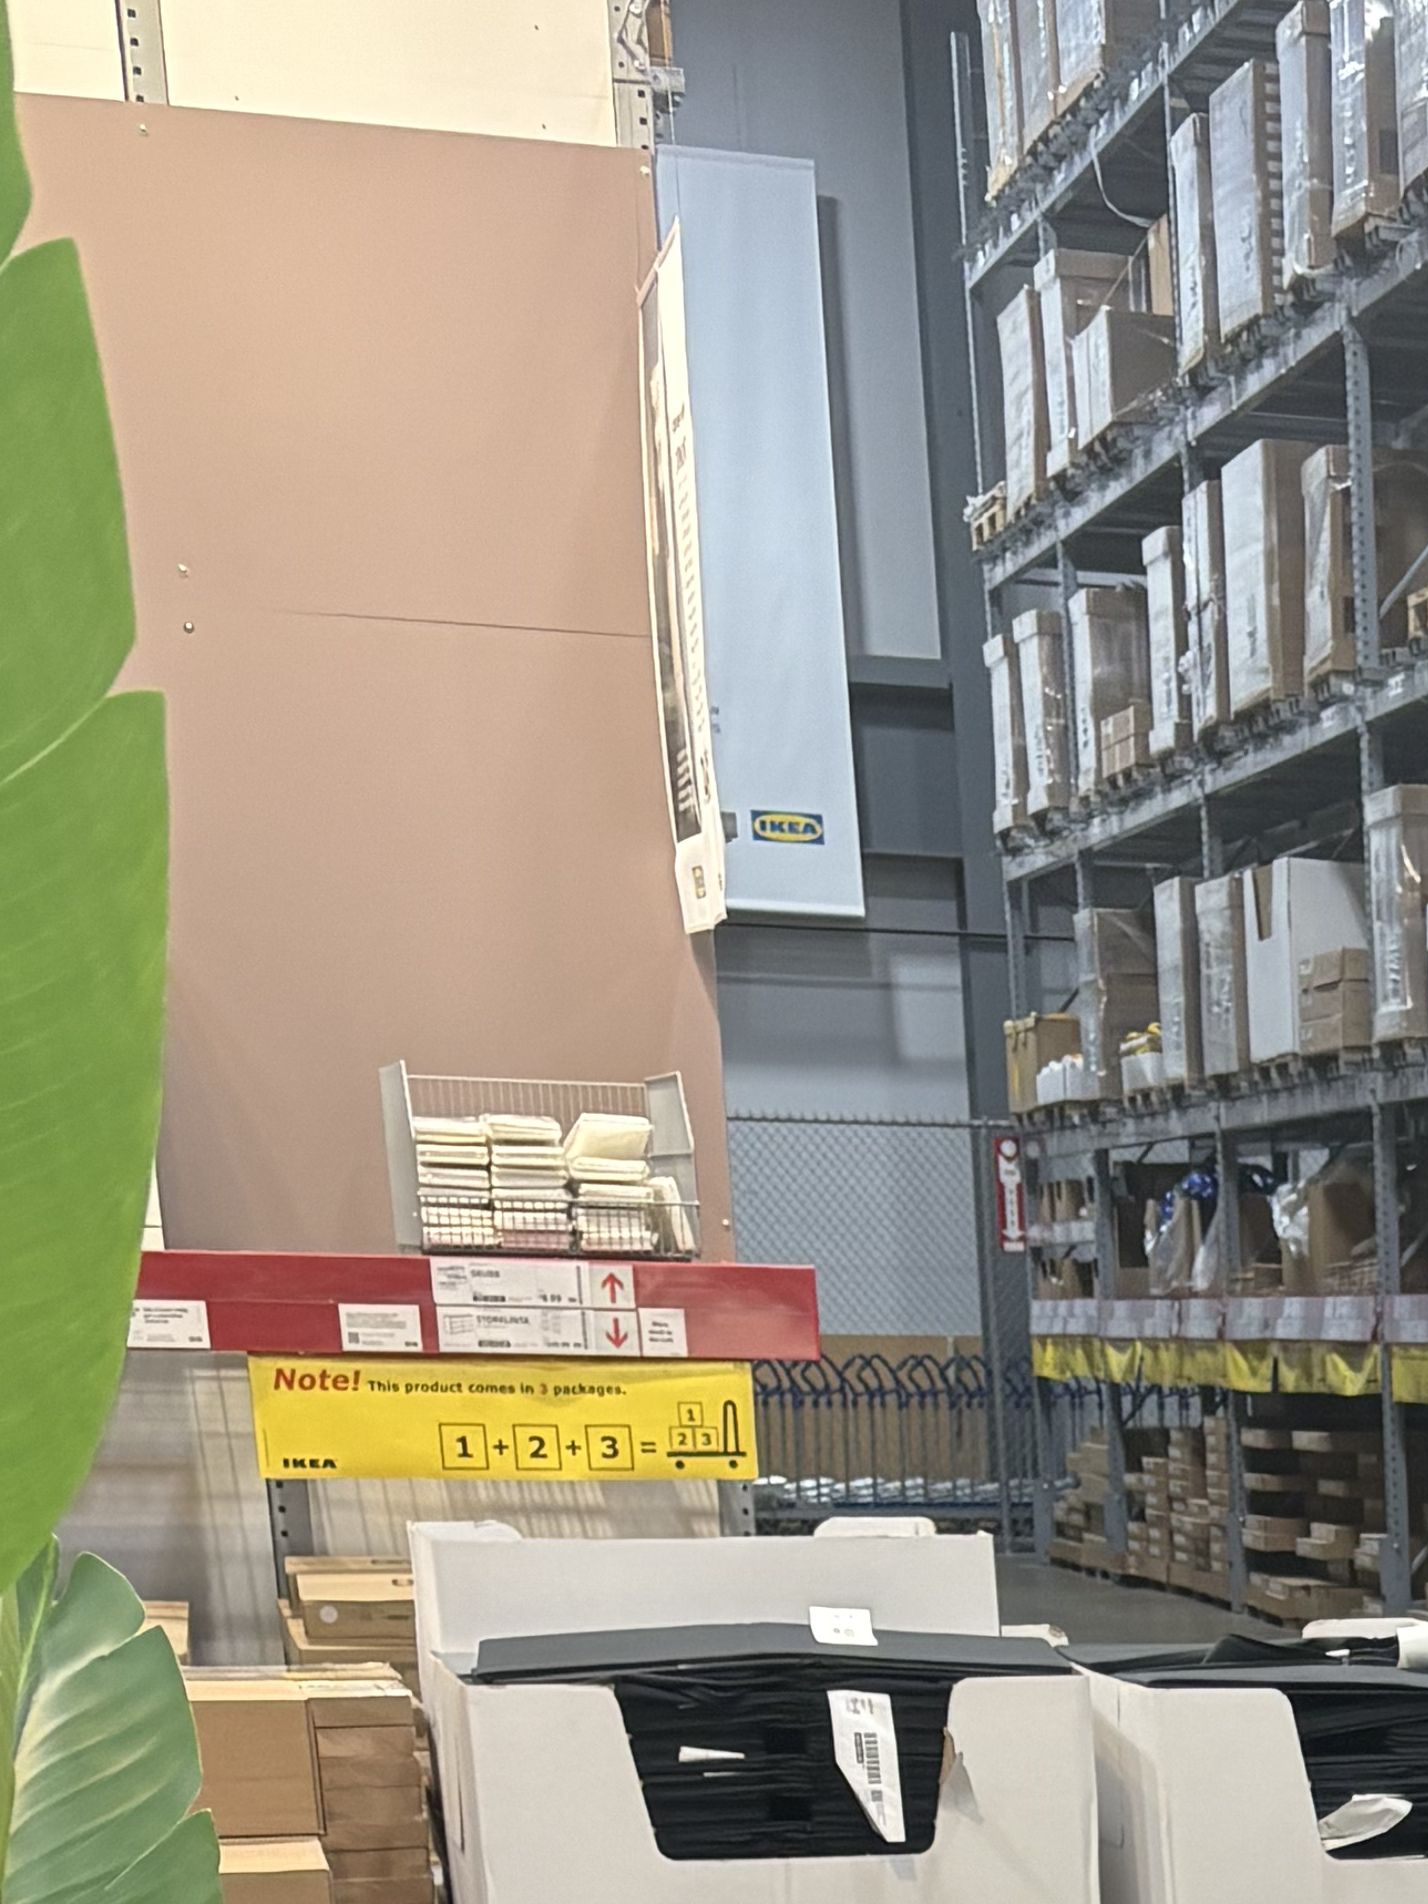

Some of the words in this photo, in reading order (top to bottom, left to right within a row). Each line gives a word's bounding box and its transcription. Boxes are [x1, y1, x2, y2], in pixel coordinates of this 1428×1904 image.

[759, 819, 818, 834] IKEA
[273, 1368, 361, 1392] Note!
[367, 1380, 400, 1392] This
[404, 1380, 463, 1394] product
[468, 1384, 516, 1394] comes
[520, 1382, 535, 1394] in
[539, 1383, 548, 1394] 3
[553, 1382, 627, 1397] packages.
[686, 1409, 696, 1422] 1
[677, 1433, 688, 1446] 2
[701, 1433, 711, 1446] 3
[455, 1435, 473, 1458] 1
[528, 1435, 548, 1459] 2
[600, 1435, 620, 1459] 3
[283, 1458, 337, 1469] IKEA
